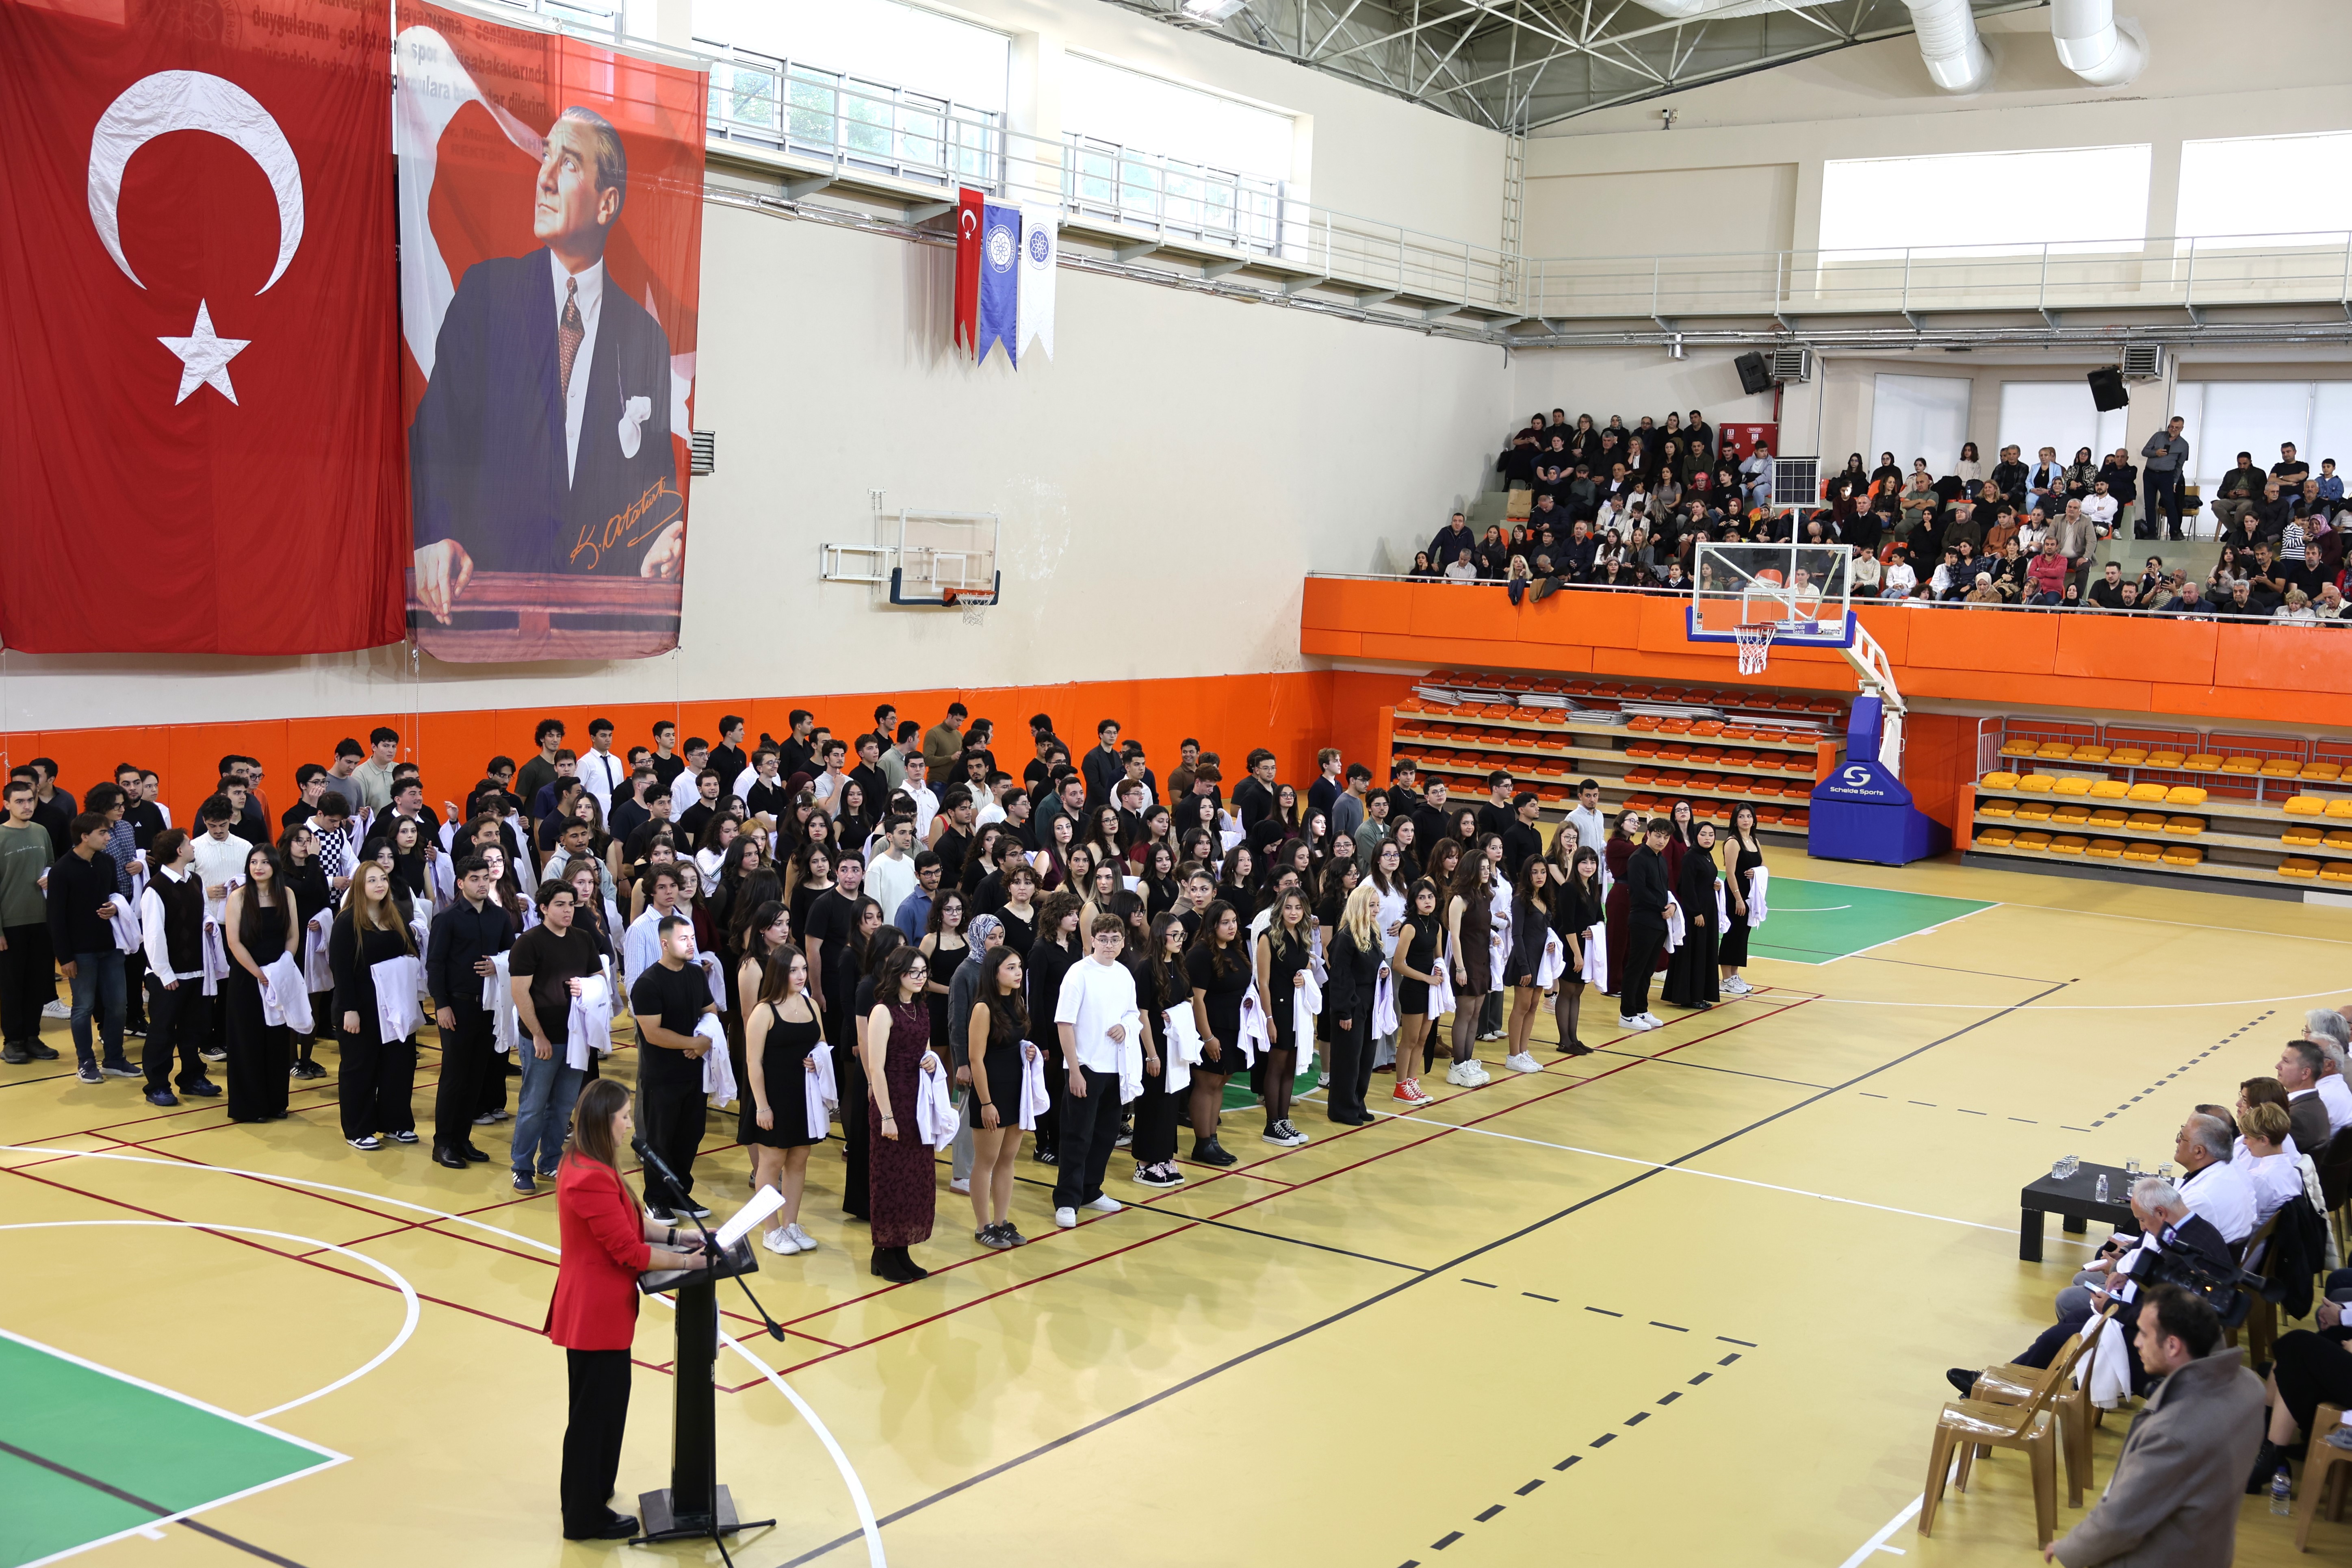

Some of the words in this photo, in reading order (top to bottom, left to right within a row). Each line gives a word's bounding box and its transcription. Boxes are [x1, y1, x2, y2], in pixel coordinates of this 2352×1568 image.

[253, 4, 329, 41] duygularını
[412, 43, 437, 66] spor
[988, 228, 999, 241] NAMIK
[999, 227, 1010, 238] KEMAL
[1028, 226, 1038, 239] NAMIK
[1038, 225, 1048, 236] KEMAL
